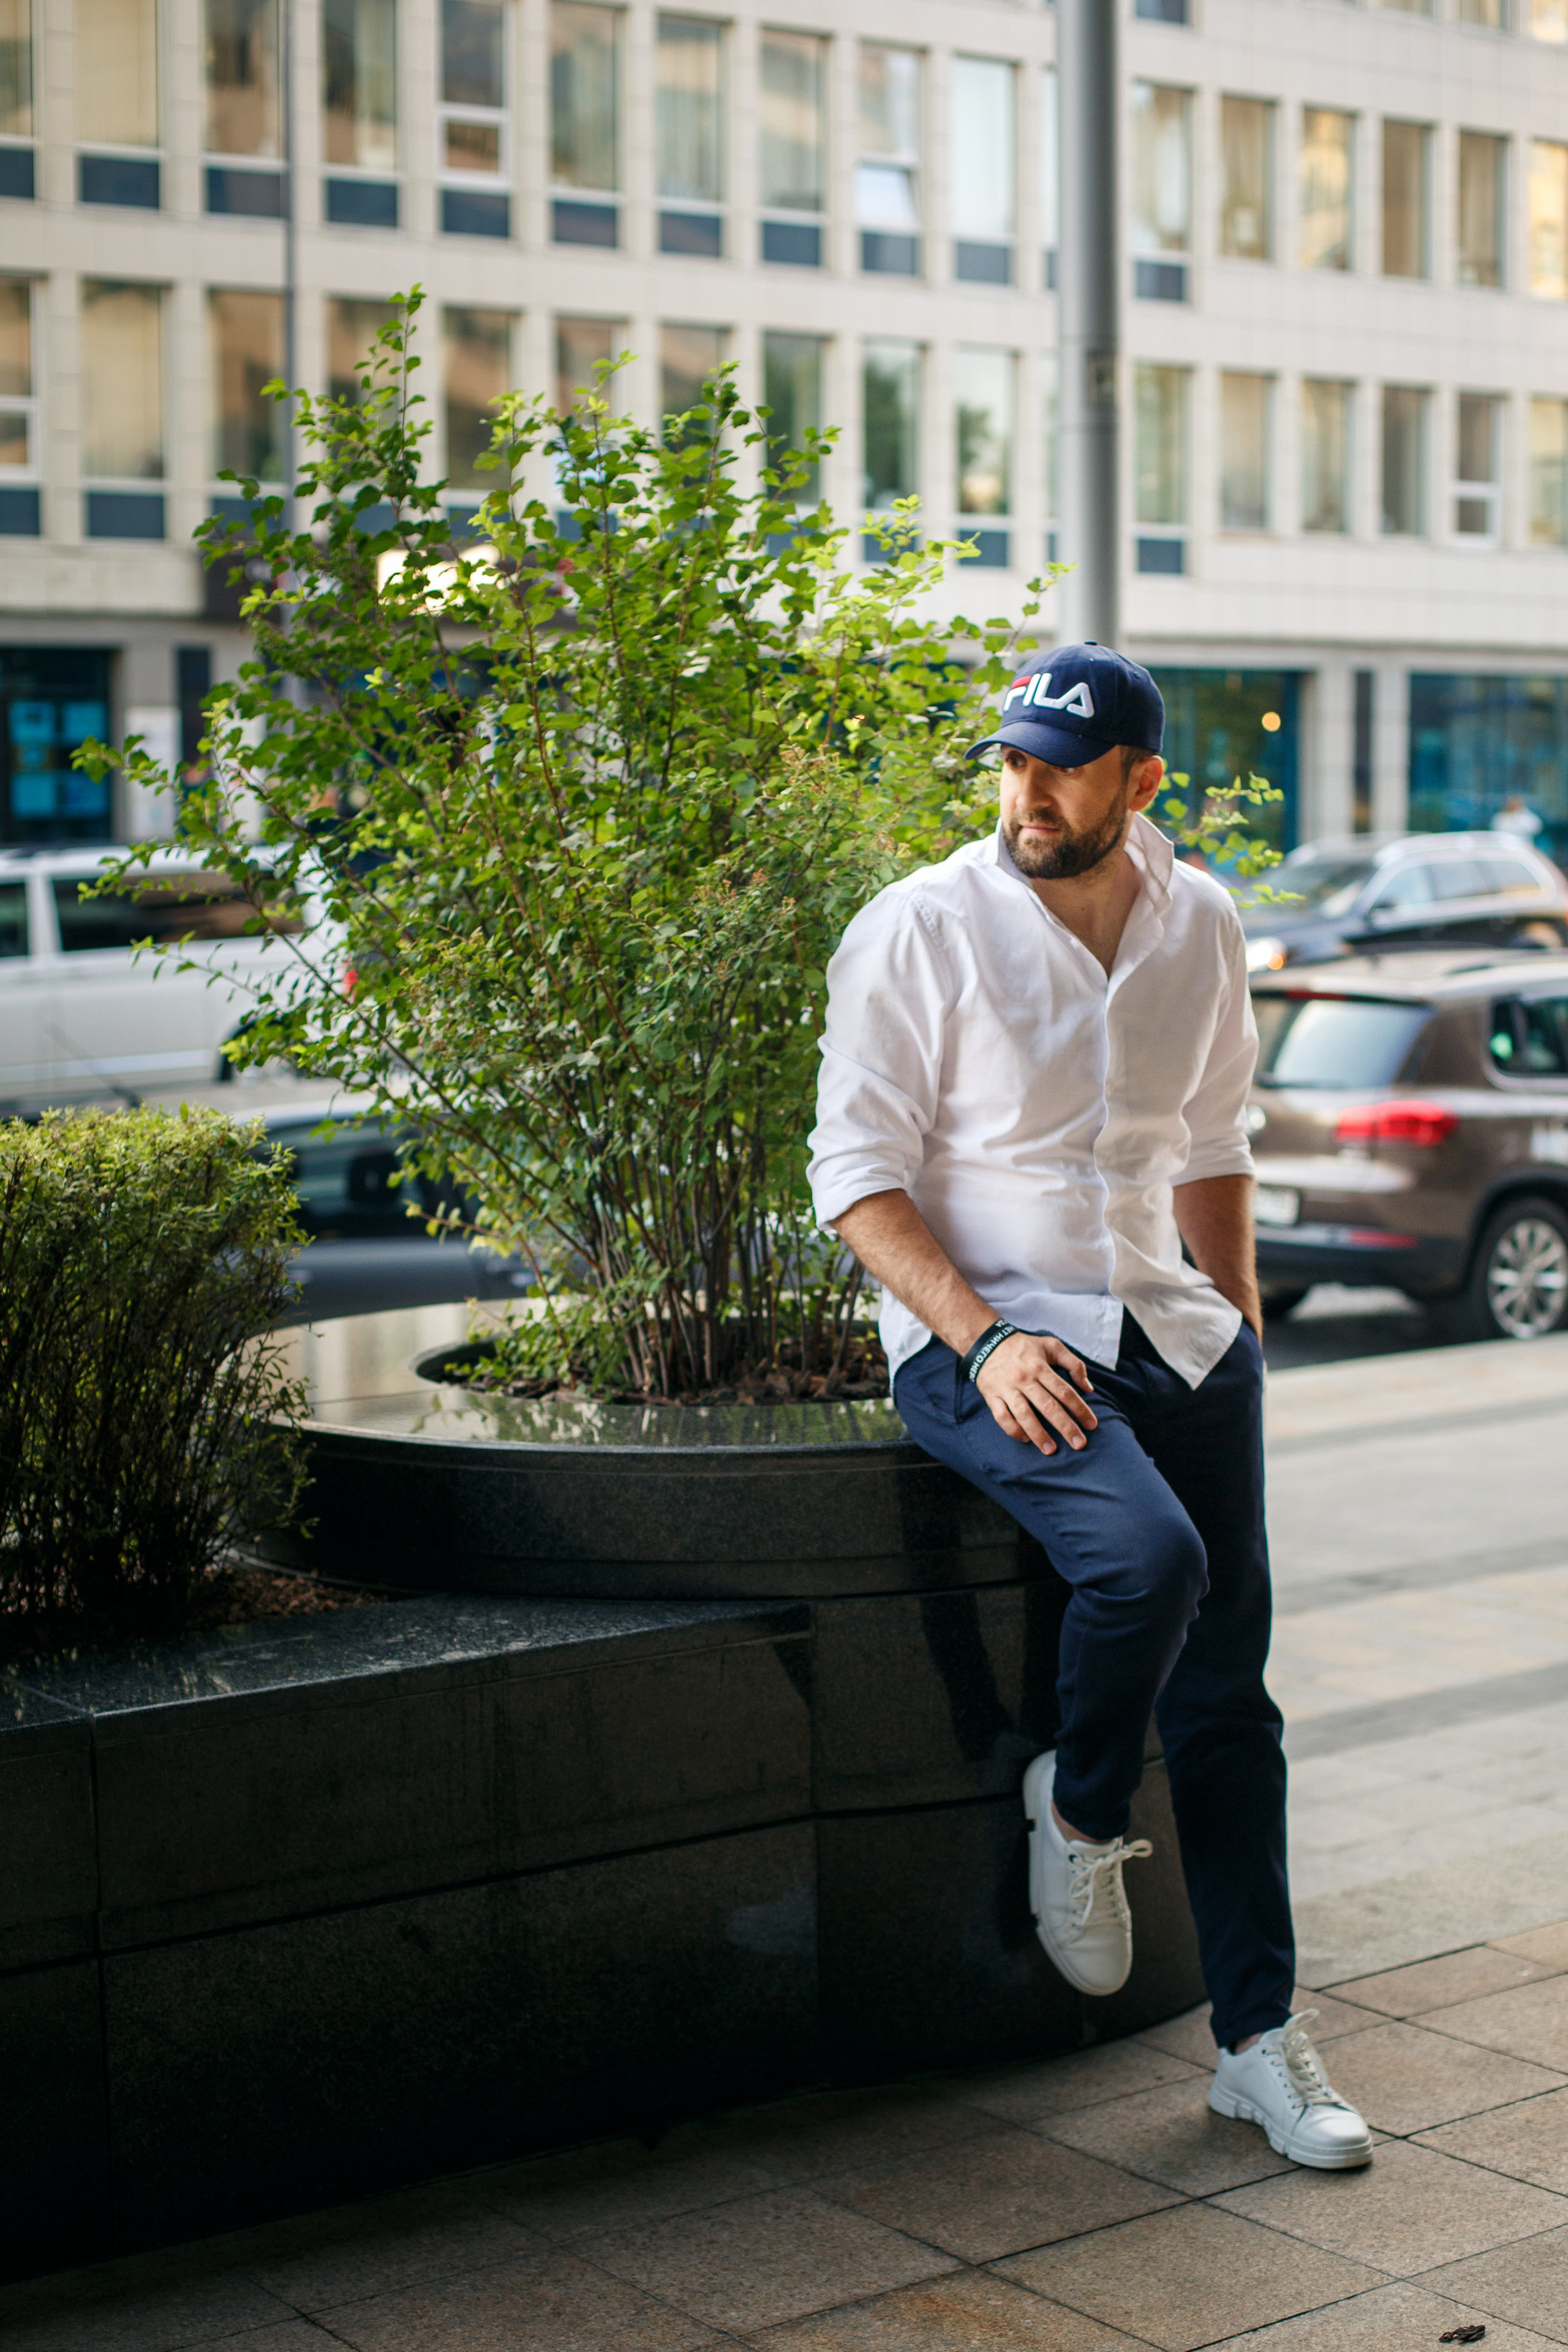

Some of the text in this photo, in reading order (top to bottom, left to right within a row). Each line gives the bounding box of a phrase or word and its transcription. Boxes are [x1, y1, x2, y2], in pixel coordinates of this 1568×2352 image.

[1003, 673, 1095, 718] FILA
[1001, 1325, 1016, 1336] НЕТ
[976, 1332, 1005, 1363] НИЧЕГО
